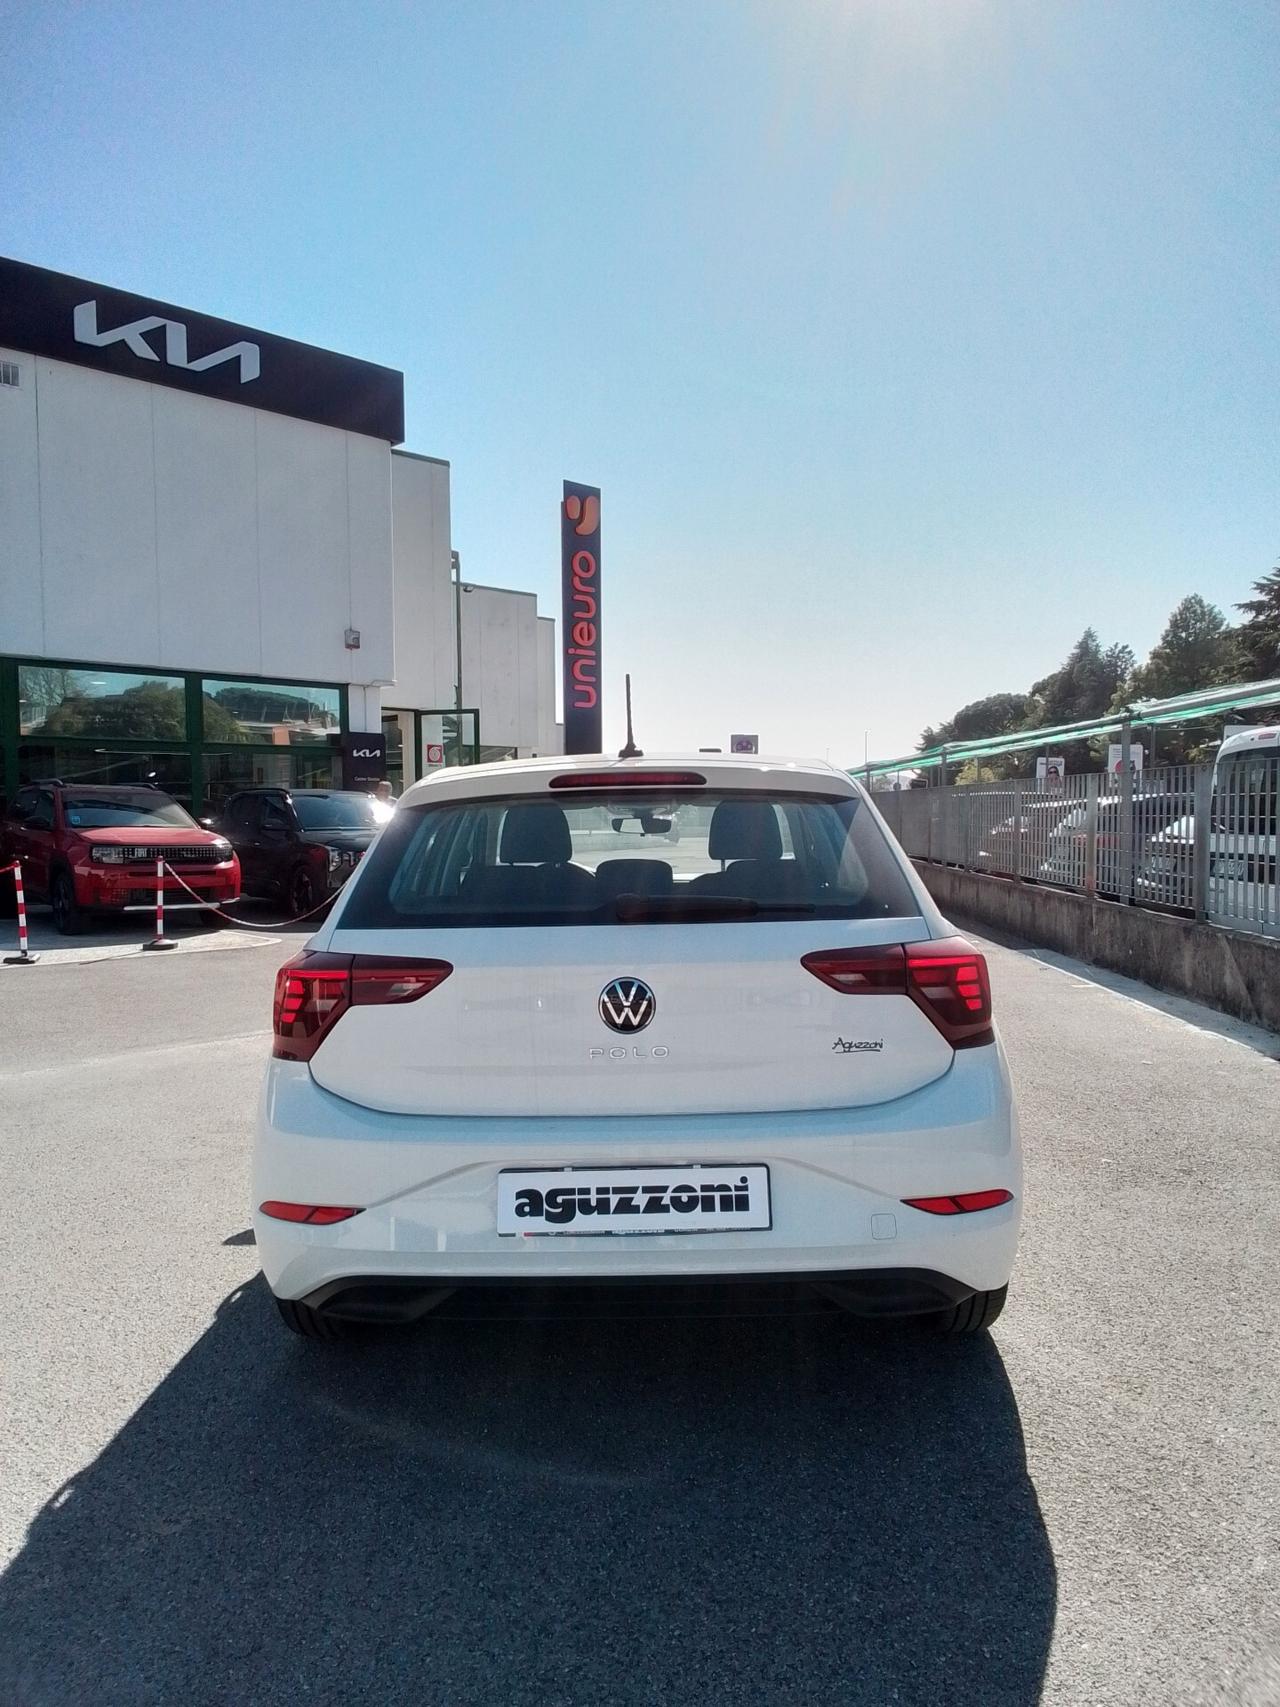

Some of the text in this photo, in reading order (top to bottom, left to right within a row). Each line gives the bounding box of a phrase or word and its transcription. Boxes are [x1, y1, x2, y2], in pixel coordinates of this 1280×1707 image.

[568, 550, 597, 709] unieuro
[589, 1045, 670, 1060] POLO
[832, 1037, 884, 1053] Aguzzoni
[514, 1175, 751, 1224] aguzzoni
